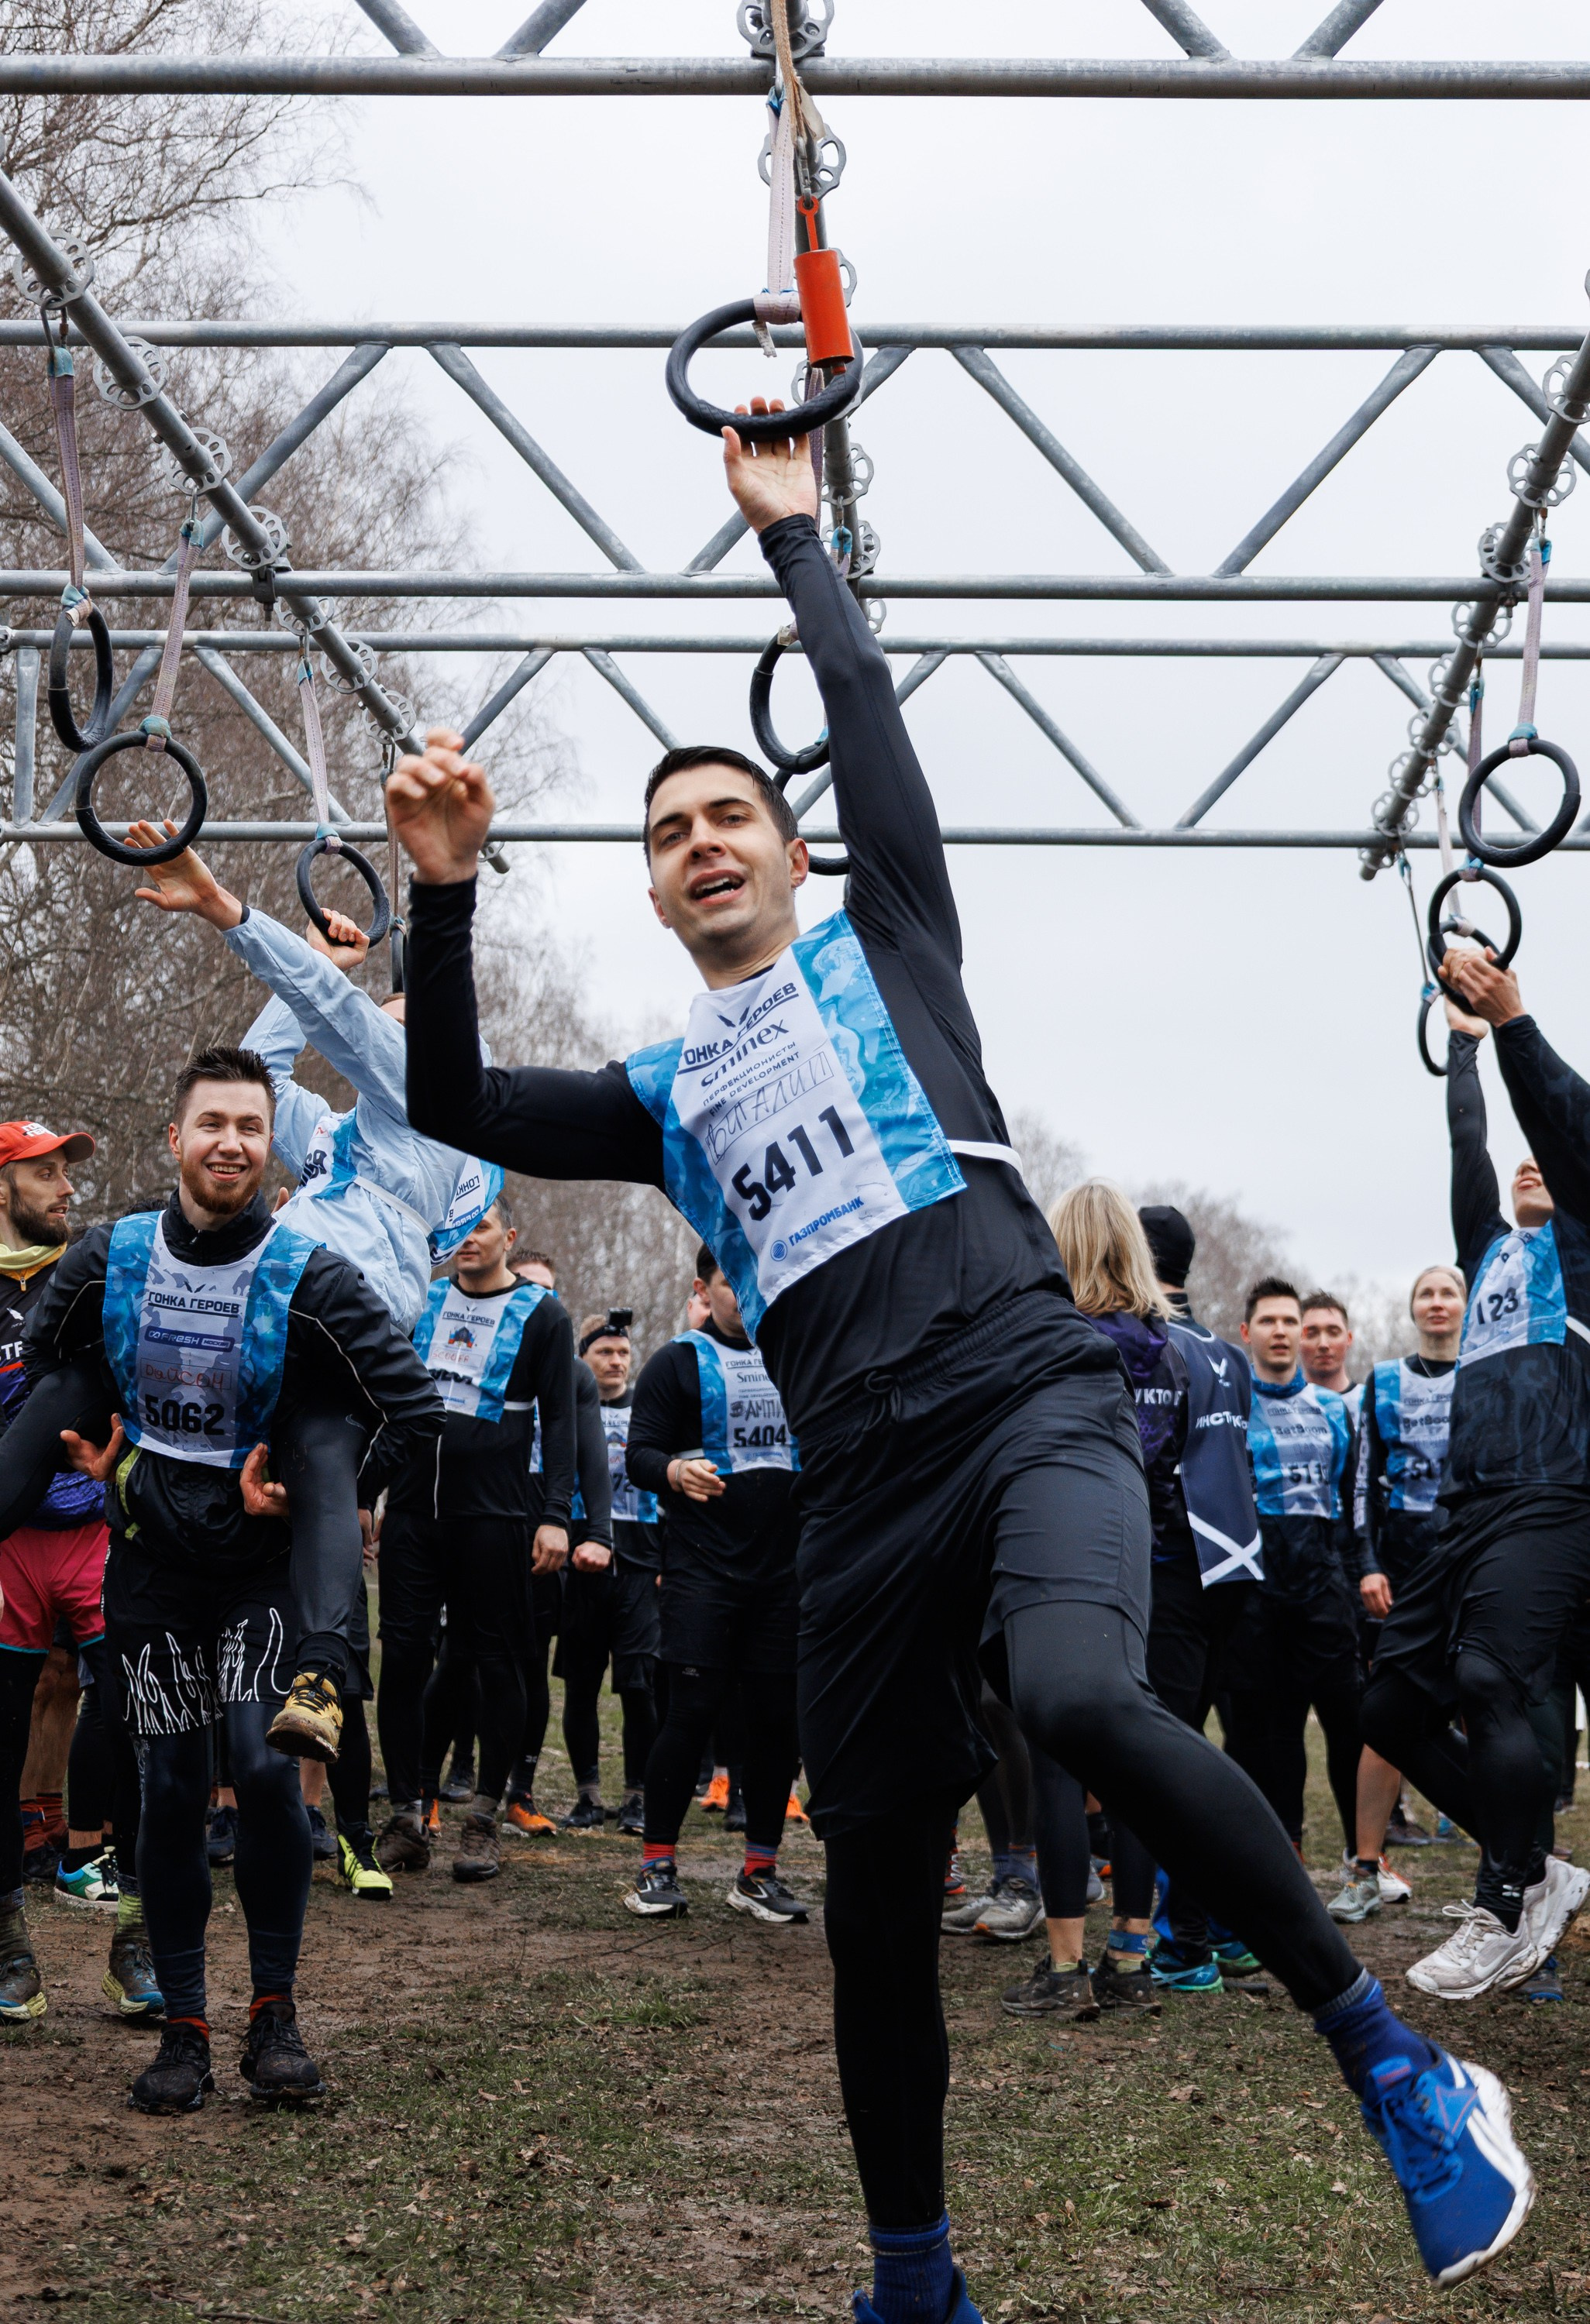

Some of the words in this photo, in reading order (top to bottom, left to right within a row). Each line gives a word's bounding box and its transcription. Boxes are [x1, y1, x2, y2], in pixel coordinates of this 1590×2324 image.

[681, 1039, 734, 1066] ОНКА
[737, 982, 797, 1038] ГЕРОЕВ
[703, 1041, 796, 1107] ПЕРФЕКЦИОНИСТЫ
[709, 1097, 727, 1117] FINE
[729, 1051, 800, 1098] DEVELOPMENT
[731, 1105, 855, 1222] 5411
[788, 1196, 865, 1247] ГАЗПРОМБАНК
[148, 1291, 186, 1308] ГОНКА
[190, 1298, 239, 1314] ГЕРОЕВ
[442, 1311, 465, 1320] ГОНКА
[466, 1314, 495, 1325] ГЕРОЕВ
[725, 1359, 752, 1367] ГОНКА
[145, 1394, 225, 1435] 5062
[733, 1424, 787, 1448] 5404
